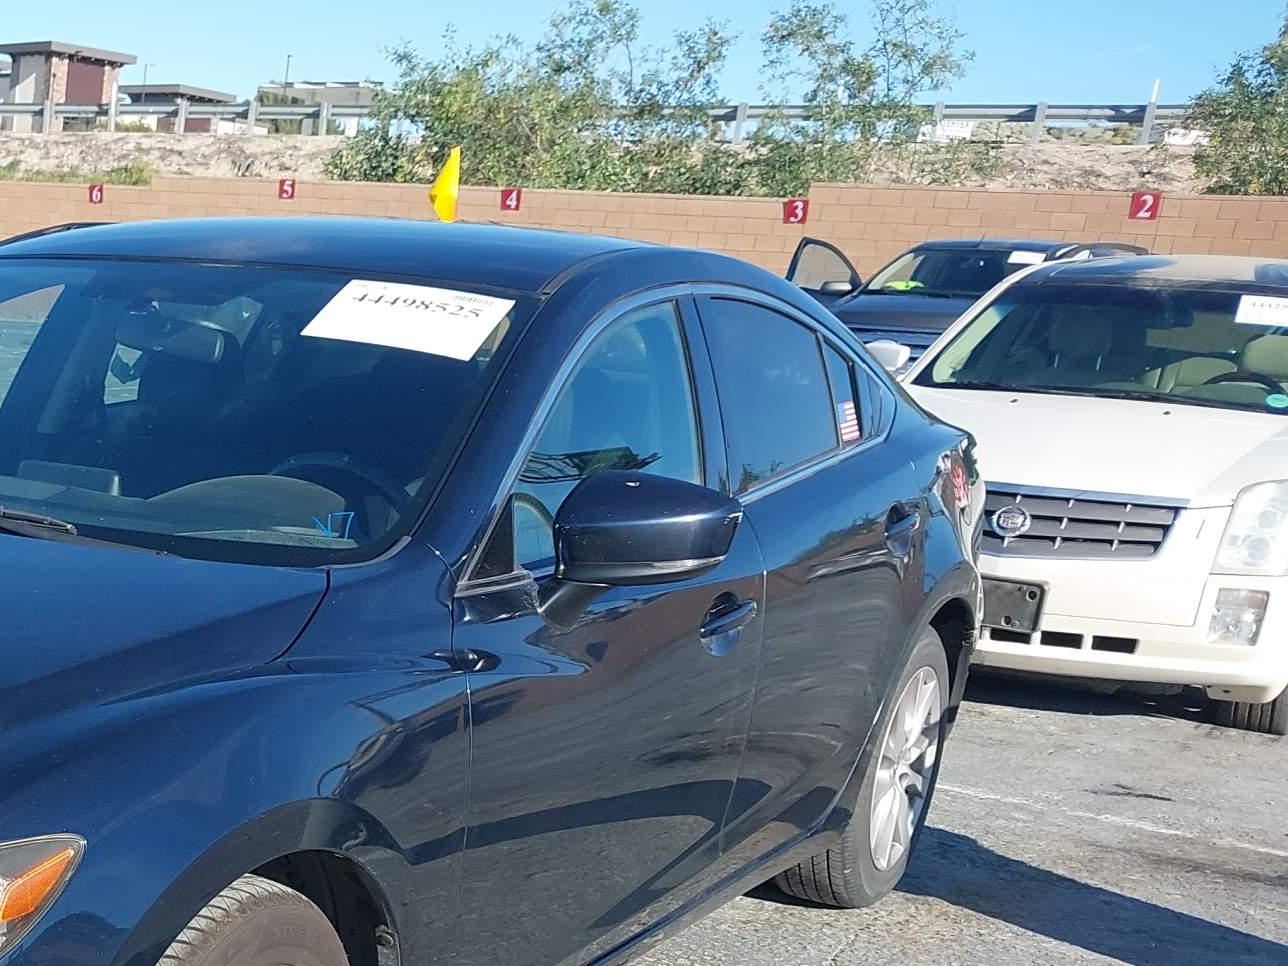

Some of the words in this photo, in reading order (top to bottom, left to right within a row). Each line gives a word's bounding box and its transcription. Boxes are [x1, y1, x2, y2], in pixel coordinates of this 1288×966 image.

[281, 180, 293, 198] 5
[505, 189, 518, 209] 4
[789, 200, 804, 222] 3
[1135, 194, 1154, 218] 2
[352, 292, 484, 320] 44498525
